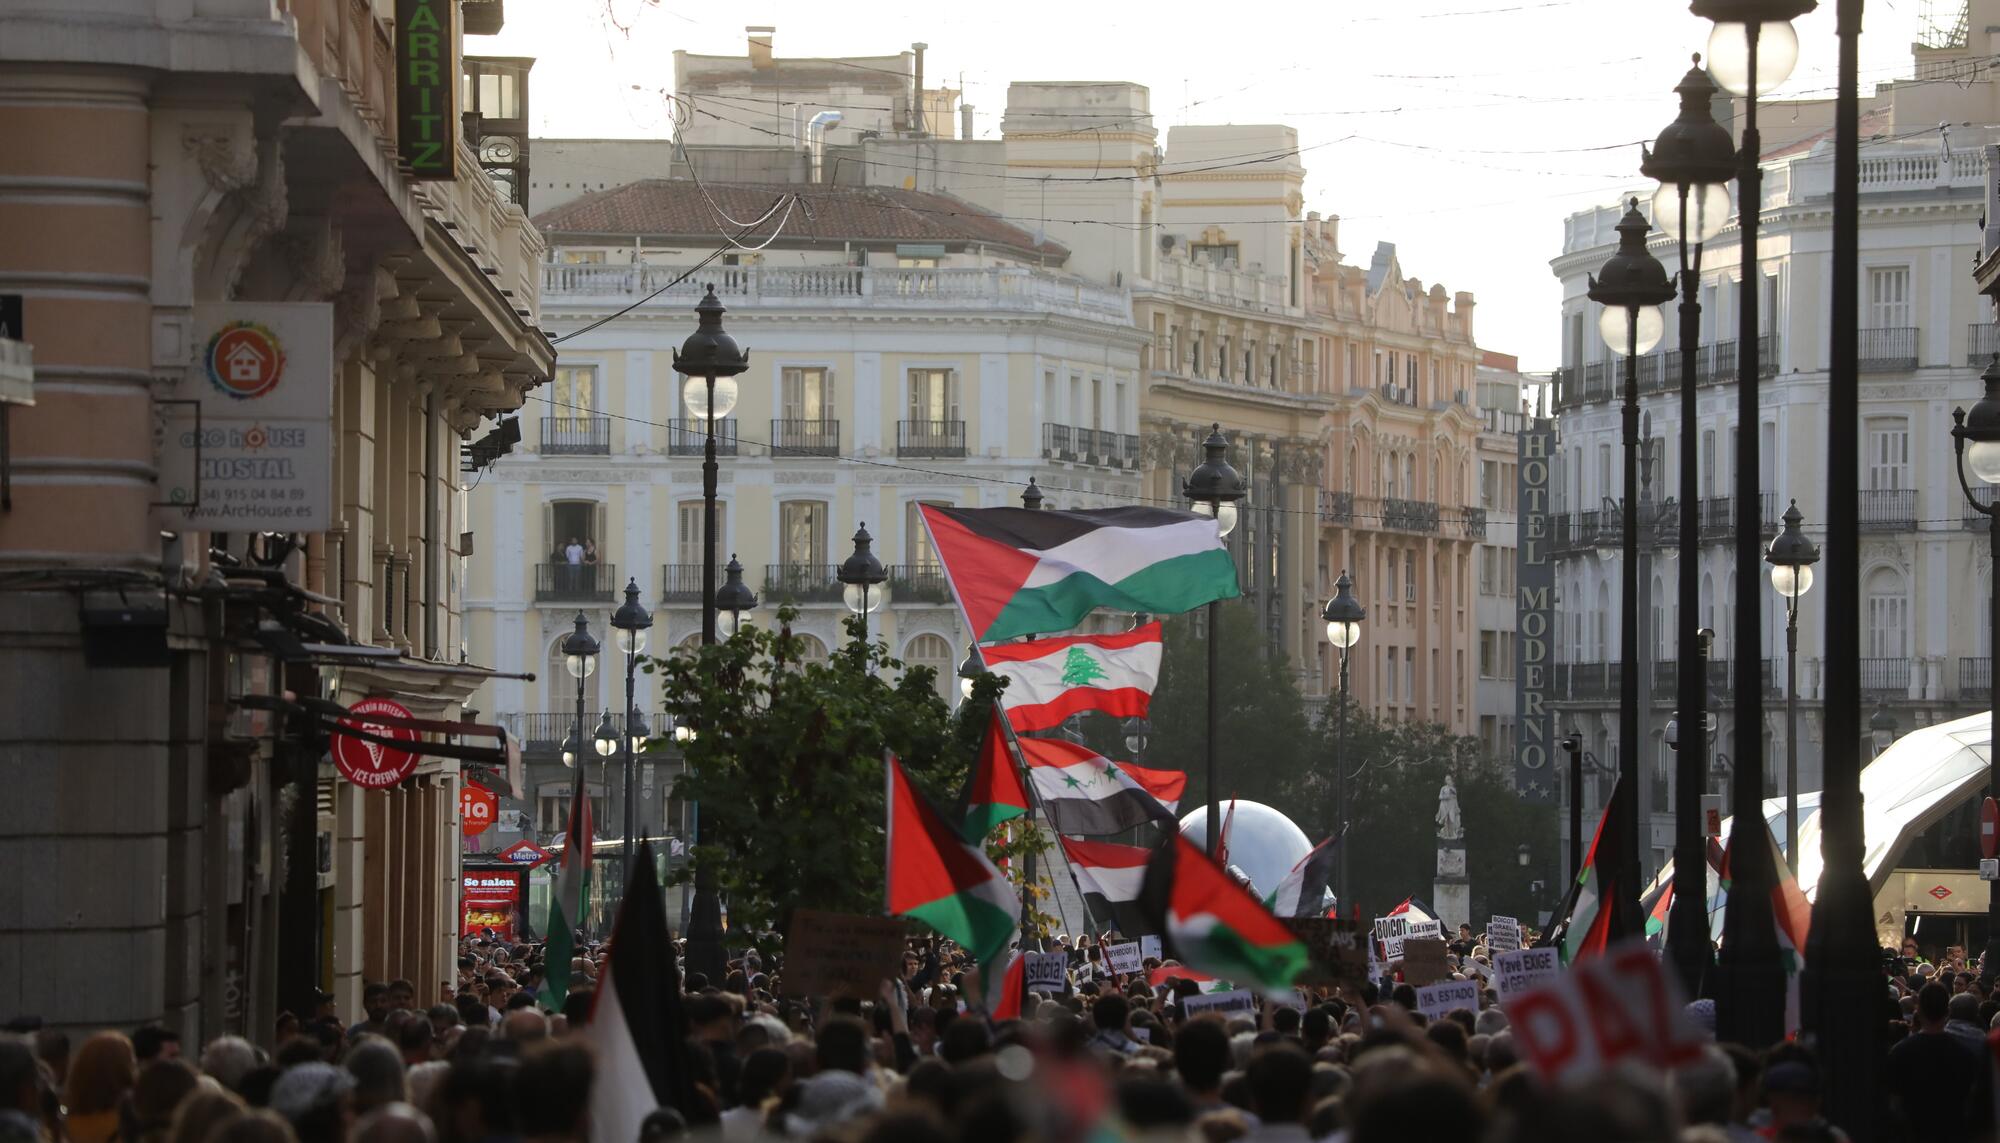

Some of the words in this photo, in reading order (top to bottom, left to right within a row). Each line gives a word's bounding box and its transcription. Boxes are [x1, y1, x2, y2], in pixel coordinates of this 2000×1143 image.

[407, 0, 442, 167] ARRITZ
[197, 458, 296, 480] HOSTAL
[1523, 434, 1549, 565] HOTEL
[1519, 586, 1550, 769] MODERNO
[352, 767, 369, 784] ICE
[513, 851, 538, 860] Metro
[464, 877, 479, 886] Se
[1523, 952, 1552, 971] EXIGE
[1438, 986, 1475, 1002] ESTADO
